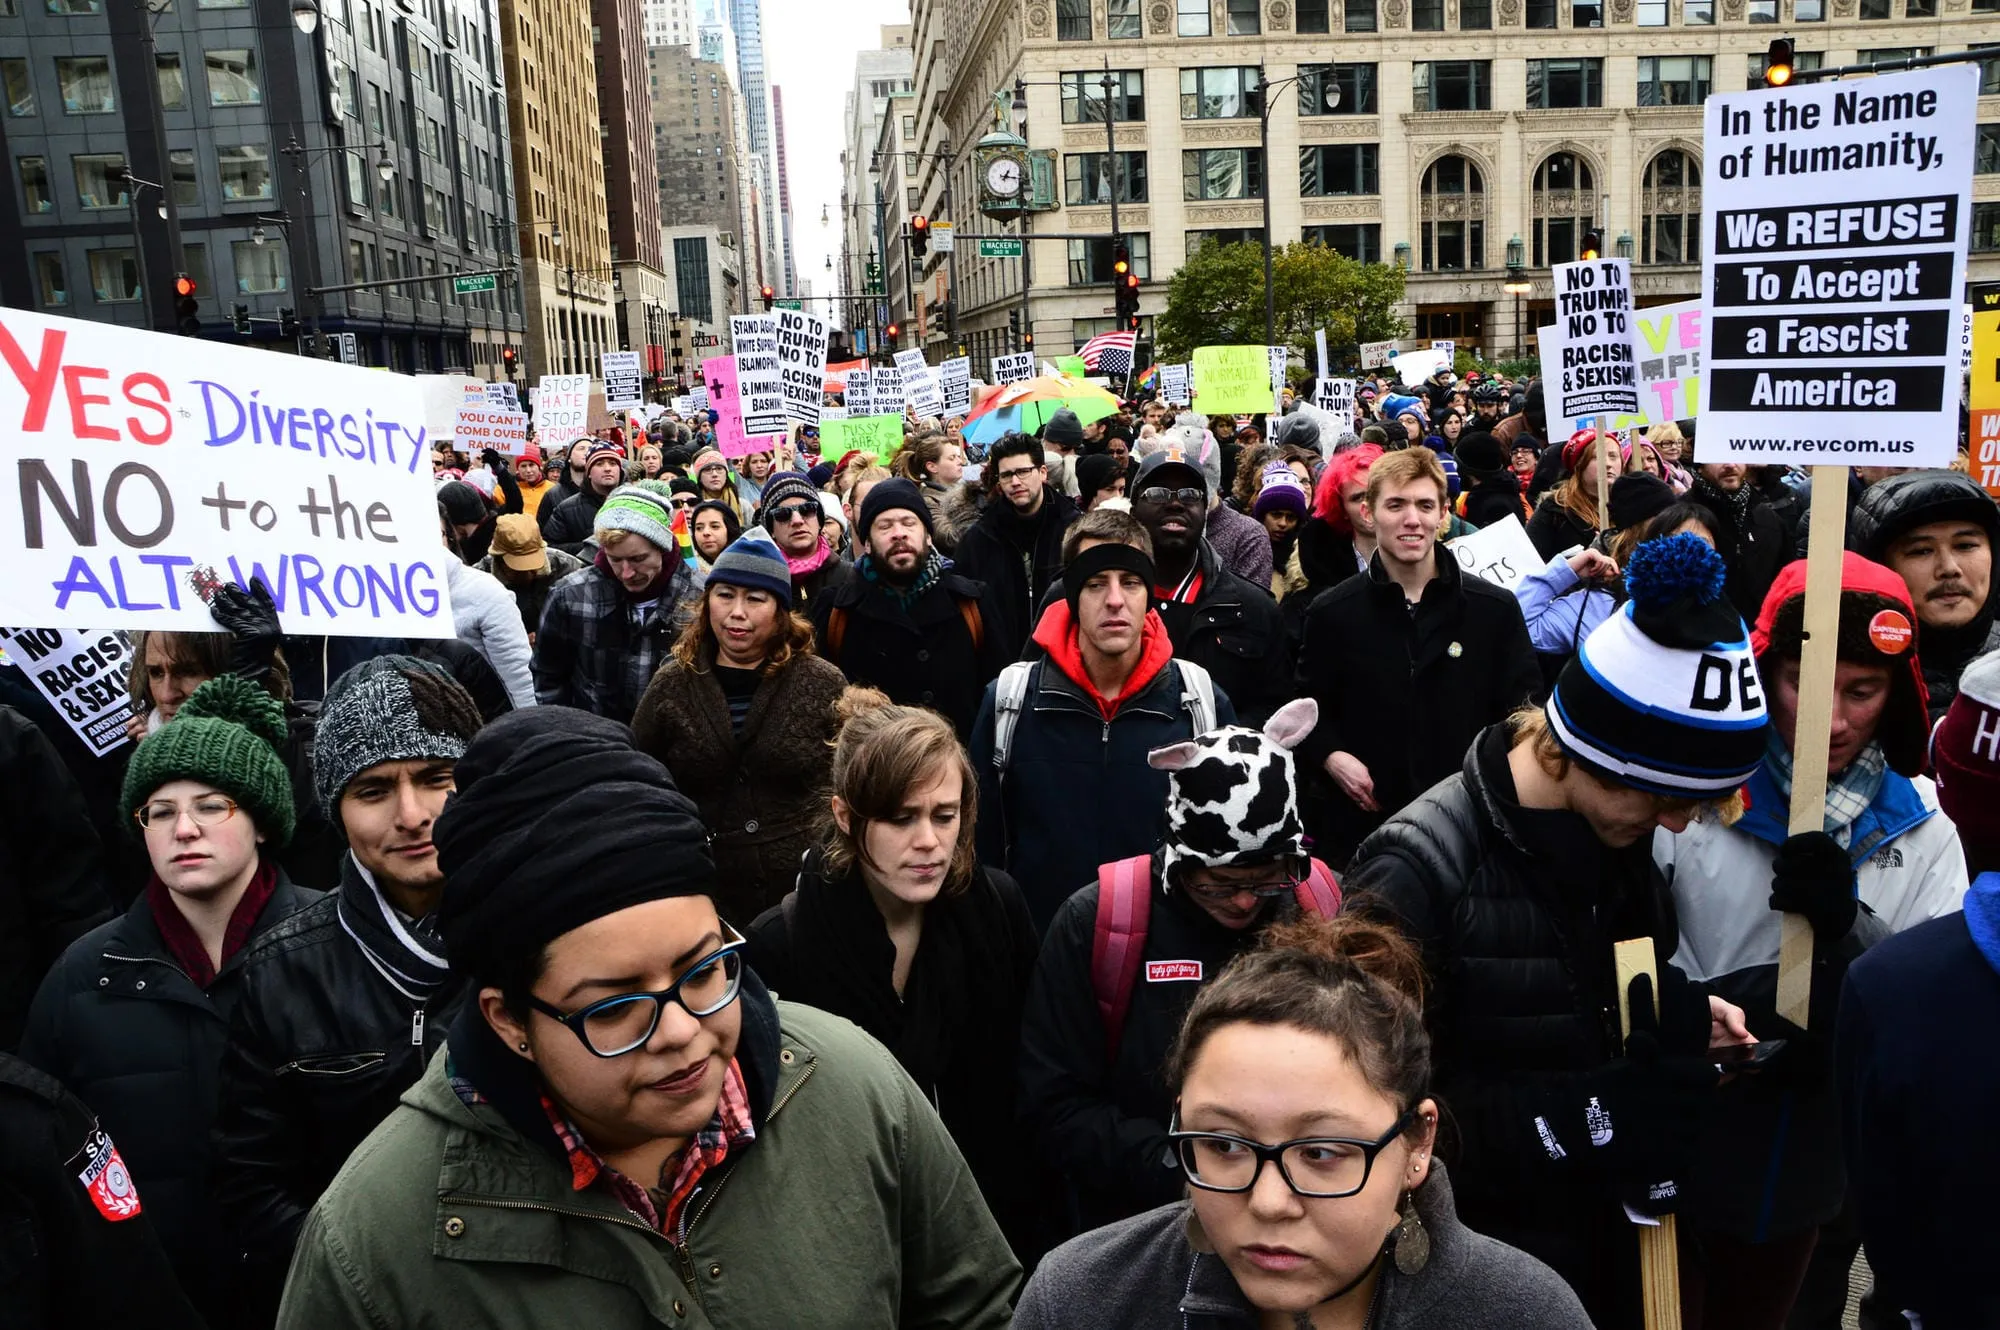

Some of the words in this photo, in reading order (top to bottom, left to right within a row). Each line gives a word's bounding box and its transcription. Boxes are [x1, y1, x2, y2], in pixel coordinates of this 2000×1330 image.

[1720, 104, 1751, 137] In
[1764, 98, 1821, 131] the
[1833, 89, 1938, 126] Name
[1719, 145, 1753, 180] of
[1764, 131, 1944, 176] Humanity,
[1724, 213, 1777, 248] We
[1787, 202, 1946, 246] REFUSE
[461, 277, 486, 285] WACKER
[1566, 267, 1594, 291] NO
[1601, 263, 1621, 286] TO
[1633, 276, 1674, 289] RIVE
[1742, 267, 1781, 300] To
[1790, 260, 1921, 303] Accept
[1457, 284, 1471, 296] 35
[1560, 288, 1628, 316] TRUMP!
[734, 320, 758, 335] STAND
[780, 313, 803, 330] NO
[808, 318, 822, 336] TO
[1569, 315, 1597, 339] NO
[1604, 311, 1626, 334] TO
[693, 335, 717, 346] PARK
[776, 328, 825, 355] TRUMP!
[1746, 326, 1767, 353] a
[1778, 318, 1910, 353] Fascist
[736, 339, 755, 353] WHITE
[1365, 343, 1393, 353] SCIENCE
[779, 345, 800, 362] NO
[805, 351, 819, 368] TO
[998, 359, 1012, 369] NO
[1014, 356, 1027, 366] TO
[1369, 359, 1389, 367] REAL
[1563, 343, 1634, 369] RACISM
[781, 368, 822, 390] ACISM
[850, 372, 859, 380] NO
[877, 369, 889, 378] NO
[995, 365, 1033, 381] TRUMP!
[1563, 372, 1573, 393] &
[1576, 365, 1636, 390] SEXISM!
[0, 319, 173, 445] YES
[177, 406, 192, 419] to
[544, 378, 583, 392] STOP
[742, 382, 748, 396] &
[1324, 382, 1340, 396] NO
[1750, 372, 1897, 407] America
[1215, 383, 1250, 400] TRUMP
[1565, 394, 1602, 406] ANSWER
[542, 393, 584, 408] HATE
[873, 397, 905, 405] RACISM
[883, 405, 904, 414] WAR!
[459, 412, 485, 423] YOU
[488, 414, 524, 426] CAN'T
[541, 411, 581, 427] STOP
[455, 425, 490, 437] COMB
[493, 428, 525, 440] OVER
[539, 426, 586, 442] TRUMP
[842, 422, 879, 436] PUSSY
[468, 440, 511, 452] RACISM
[1729, 436, 1915, 454] www.revcom.us
[18, 459, 175, 549] NO
[201, 481, 278, 532] to
[298, 474, 399, 544] the
[52, 555, 194, 611] ALT
[227, 554, 440, 619] WRONG
[14, 628, 63, 662] NO
[59, 697, 89, 722] &
[87, 707, 134, 737] ANSWER
[1972, 710, 2000, 762] H
[1151, 965, 1165, 977] ugly
[1166, 964, 1180, 976] girl
[1179, 964, 1197, 976] gang
[1585, 1107, 1597, 1131] FACE
[1589, 1097, 1605, 1131] NORTH
[1601, 1110, 1613, 1130] THE
